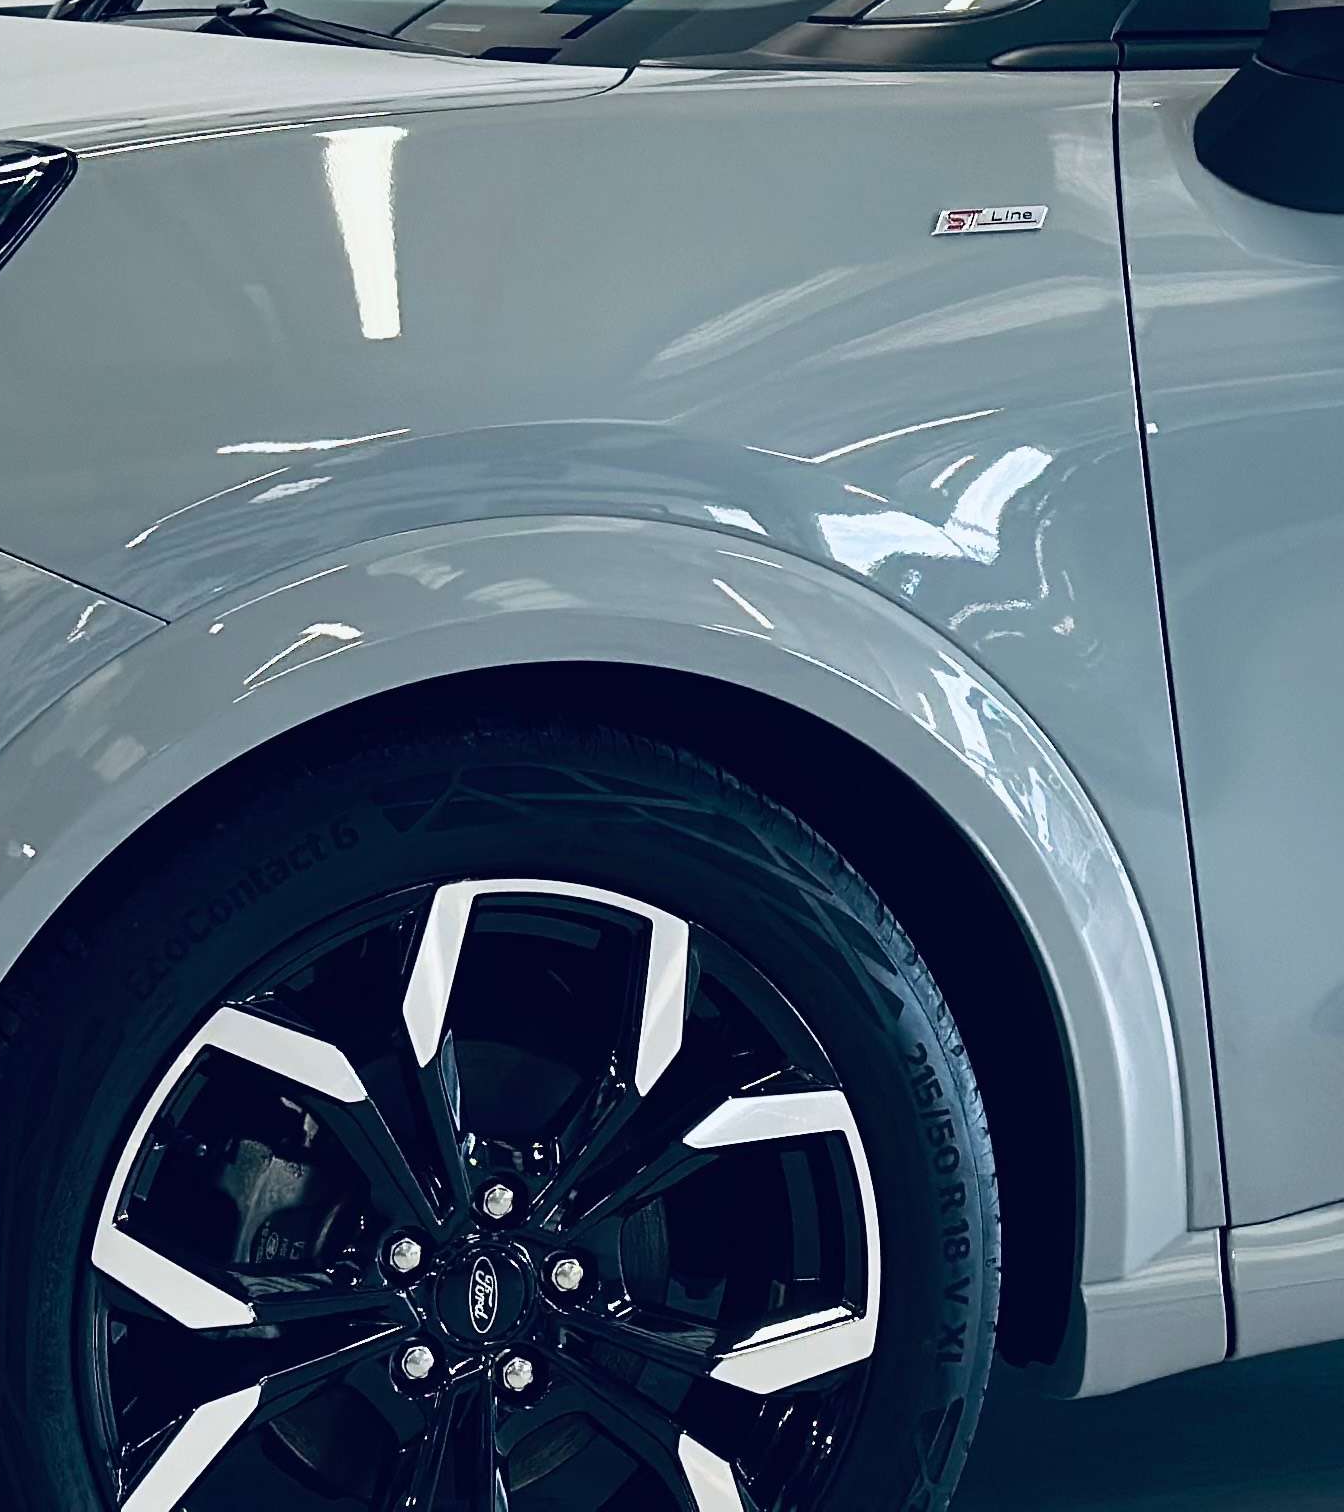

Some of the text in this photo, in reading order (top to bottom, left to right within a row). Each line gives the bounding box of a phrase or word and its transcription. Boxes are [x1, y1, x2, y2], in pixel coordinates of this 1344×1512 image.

[126, 832, 328, 1001] EcoContact
[902, 1041, 961, 1176] 215/50
[937, 1181, 967, 1215] R
[940, 1220, 973, 1264] 18
[474, 1269, 494, 1320] Ford
